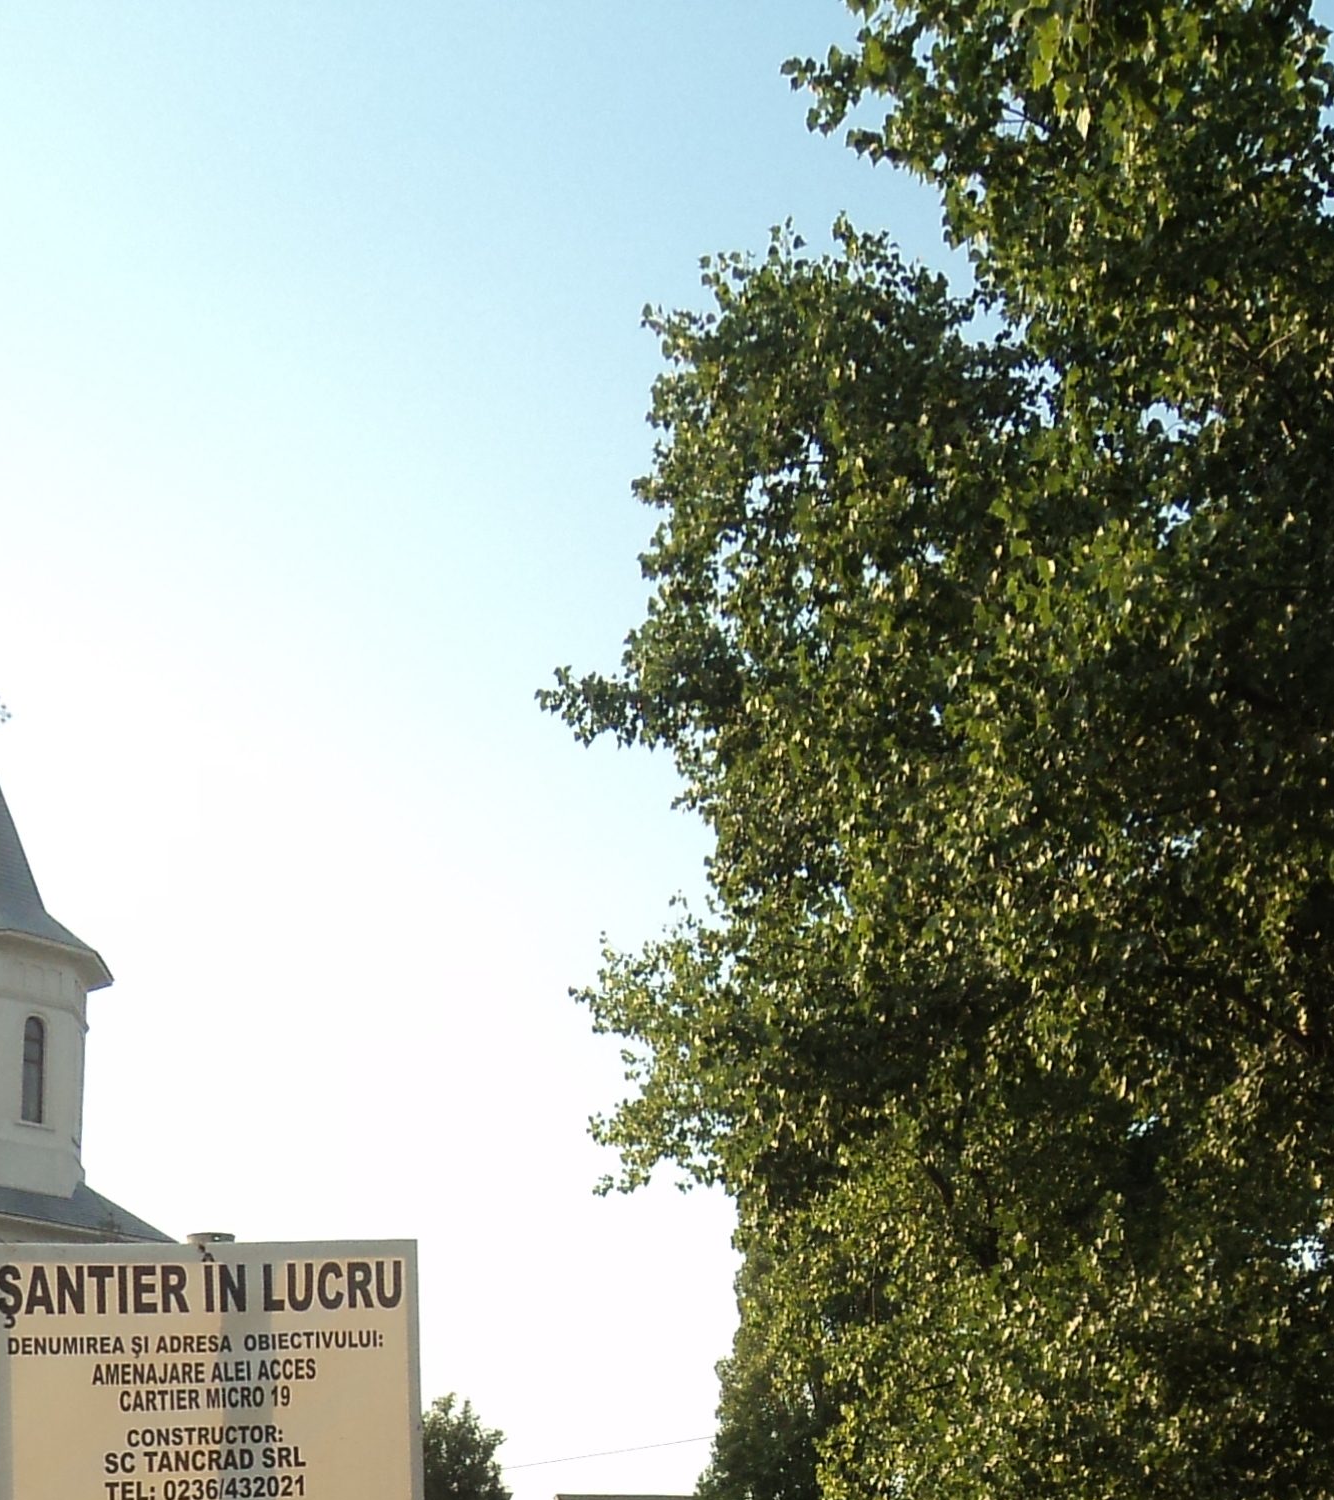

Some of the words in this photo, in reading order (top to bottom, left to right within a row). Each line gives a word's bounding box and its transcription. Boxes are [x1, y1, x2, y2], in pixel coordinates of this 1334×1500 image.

[263, 1260, 403, 1311] LUCRU
[7, 1336, 124, 1355] DENUMIREA
[156, 1335, 232, 1354] ADRESA
[244, 1330, 384, 1351] OBIECTIVULUI:
[91, 1362, 205, 1385] AMENAJARE
[211, 1360, 251, 1381] ALEI
[258, 1358, 316, 1380] ACCES
[119, 1389, 200, 1412] CARTIER
[270, 1385, 290, 1407] 19
[127, 1426, 283, 1447] CONSTRUCTOR:
[104, 1451, 135, 1474] SC
[144, 1448, 254, 1472] TANCRAD
[262, 1446, 306, 1468] SRL
